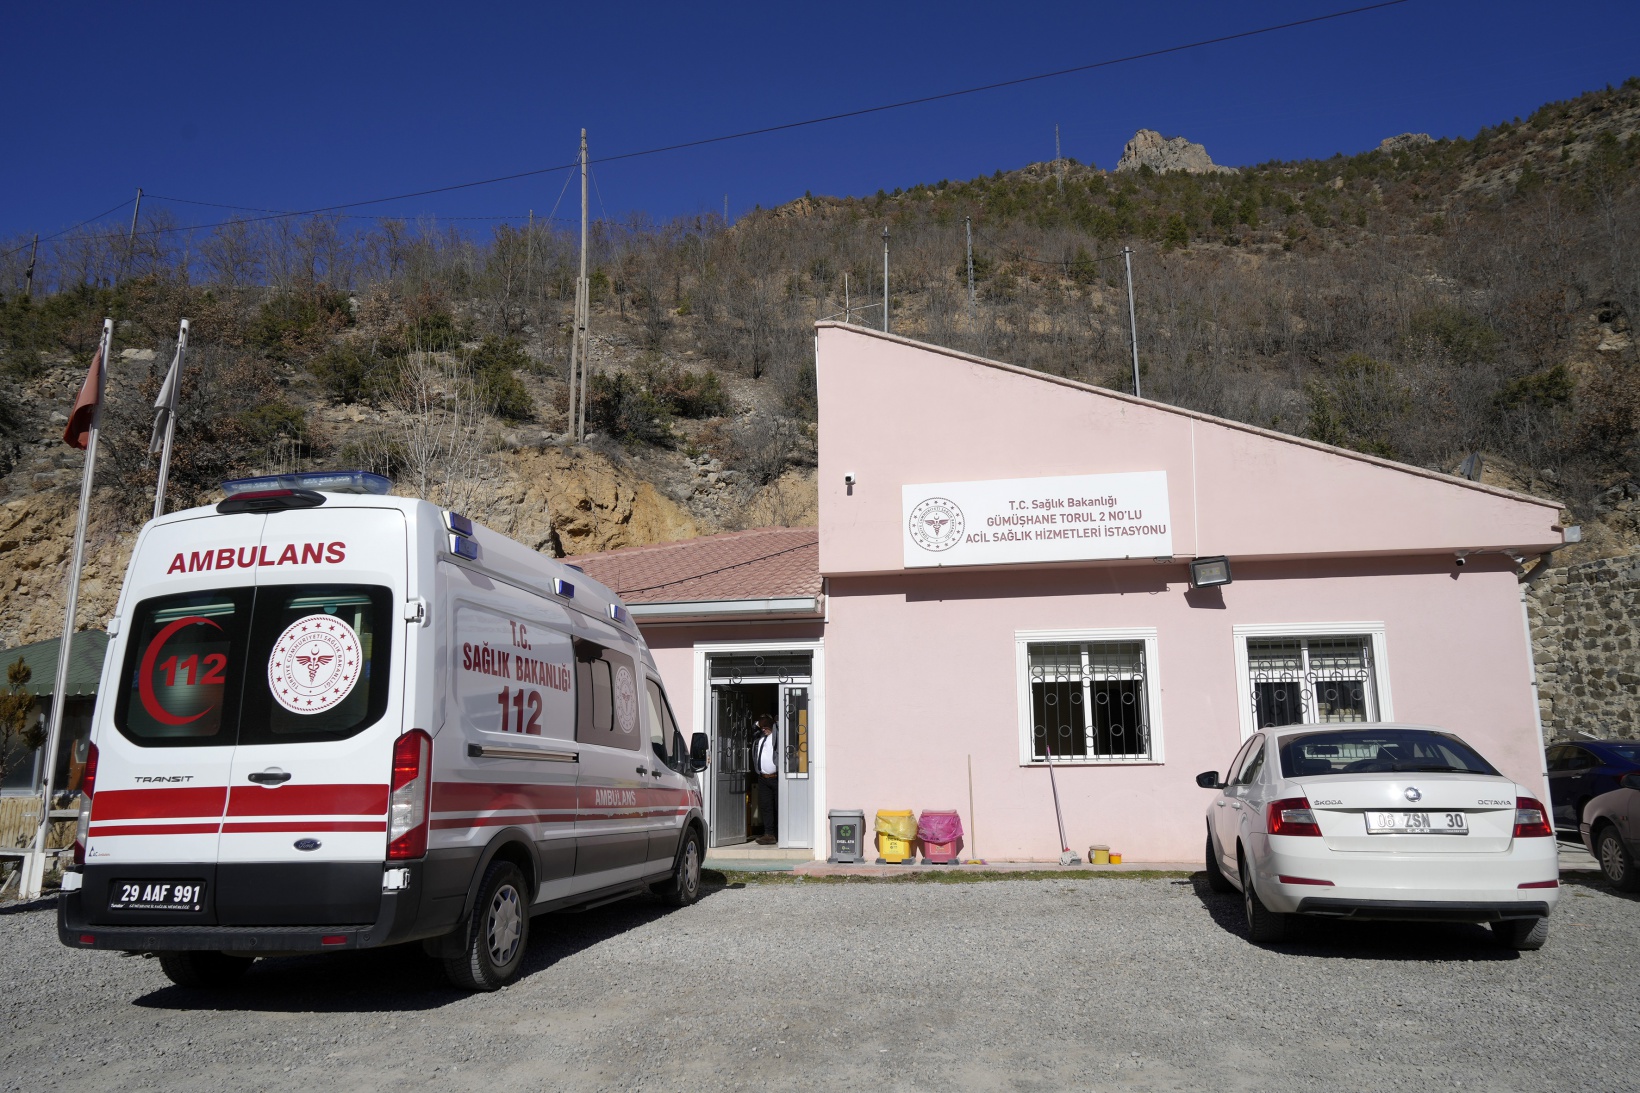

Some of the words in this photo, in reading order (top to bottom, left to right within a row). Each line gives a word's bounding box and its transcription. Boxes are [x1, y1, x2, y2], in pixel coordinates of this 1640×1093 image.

[1008, 500, 1029, 510] T.C.
[1031, 498, 1065, 511] Sağlık
[1067, 495, 1117, 508] Bakanlığı
[986, 513, 1057, 528] GÜMÜŞHANE
[1060, 511, 1097, 523] TORUL
[1099, 511, 1106, 522] 2
[965, 530, 991, 544] ACİL
[992, 528, 1033, 542] SAĞLIK
[1035, 525, 1101, 541] HİZMETLERİ
[1104, 524, 1167, 538] İSTASYONU
[167, 541, 347, 575] AMBULANS
[509, 620, 532, 651] T.C.
[159, 652, 228, 687] 112
[463, 640, 511, 679] SAĞLIK
[515, 654, 572, 693] BAKANLIĞI
[497, 685, 543, 736] 112
[134, 775, 194, 783] TRANSIT
[595, 788, 637, 806] AMBULANS
[1403, 812, 1432, 828] ZSN
[1445, 813, 1465, 828] 30
[120, 884, 140, 902] 29
[142, 884, 171, 902] AAF
[173, 885, 200, 903] 991
